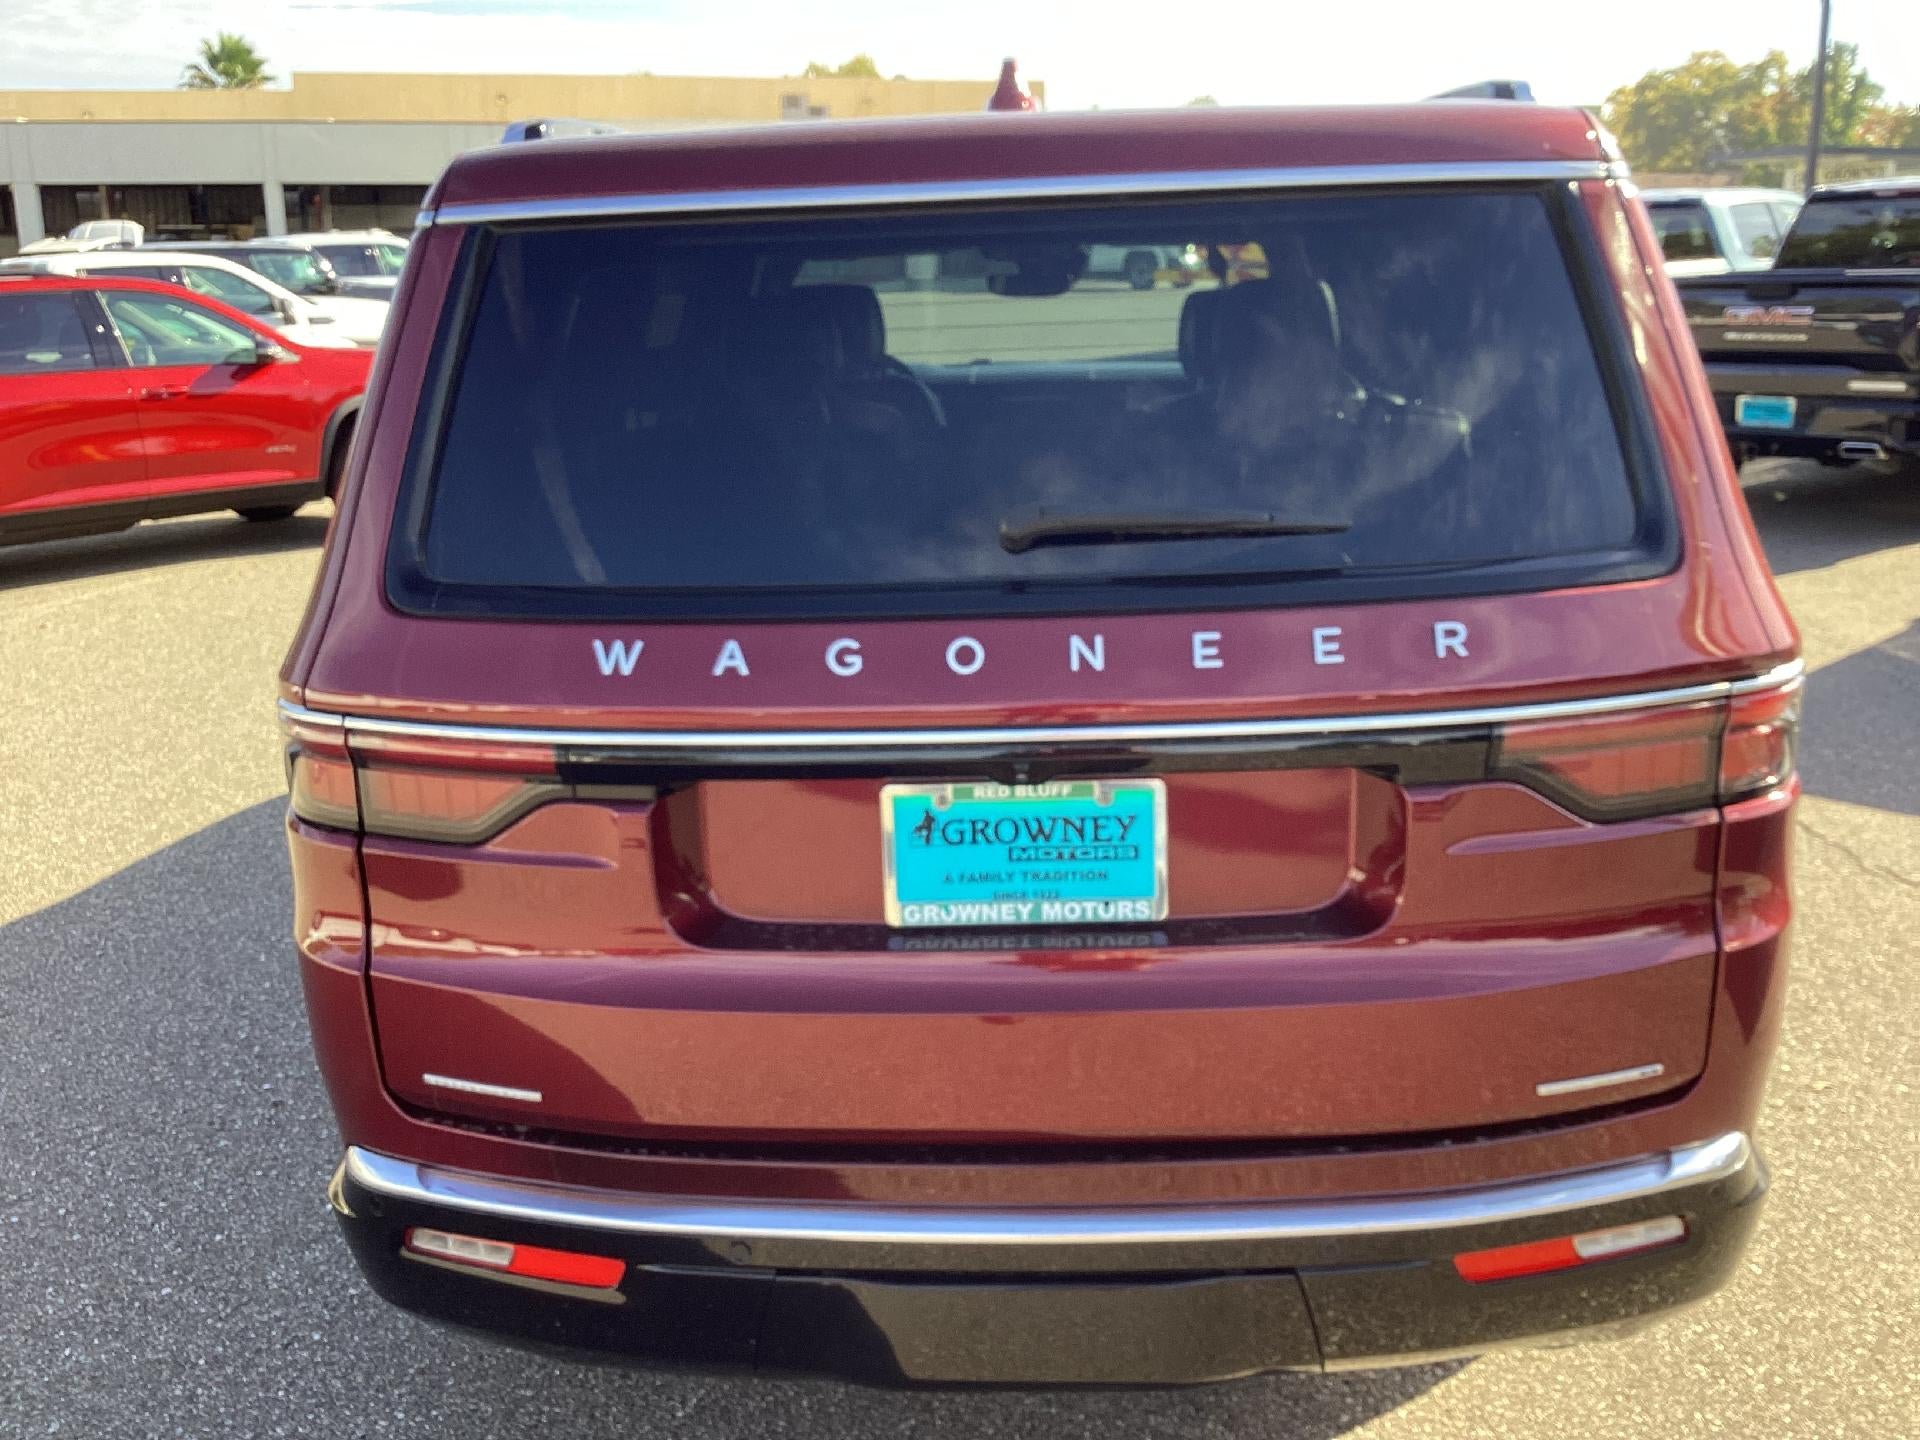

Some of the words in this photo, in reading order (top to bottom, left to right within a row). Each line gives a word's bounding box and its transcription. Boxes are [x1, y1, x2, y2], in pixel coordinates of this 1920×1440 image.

[592, 621, 1470, 677] WAGONEER
[973, 784, 1010, 798] RED
[1014, 783, 1072, 798] BLUFF
[941, 814, 1136, 845] GROWNEY
[944, 874, 954, 884] A
[959, 871, 1014, 884] FAMILY
[1023, 869, 1109, 882] TRADITION
[904, 902, 1034, 924] GROWNEY
[1041, 899, 1150, 921] MOTORS
